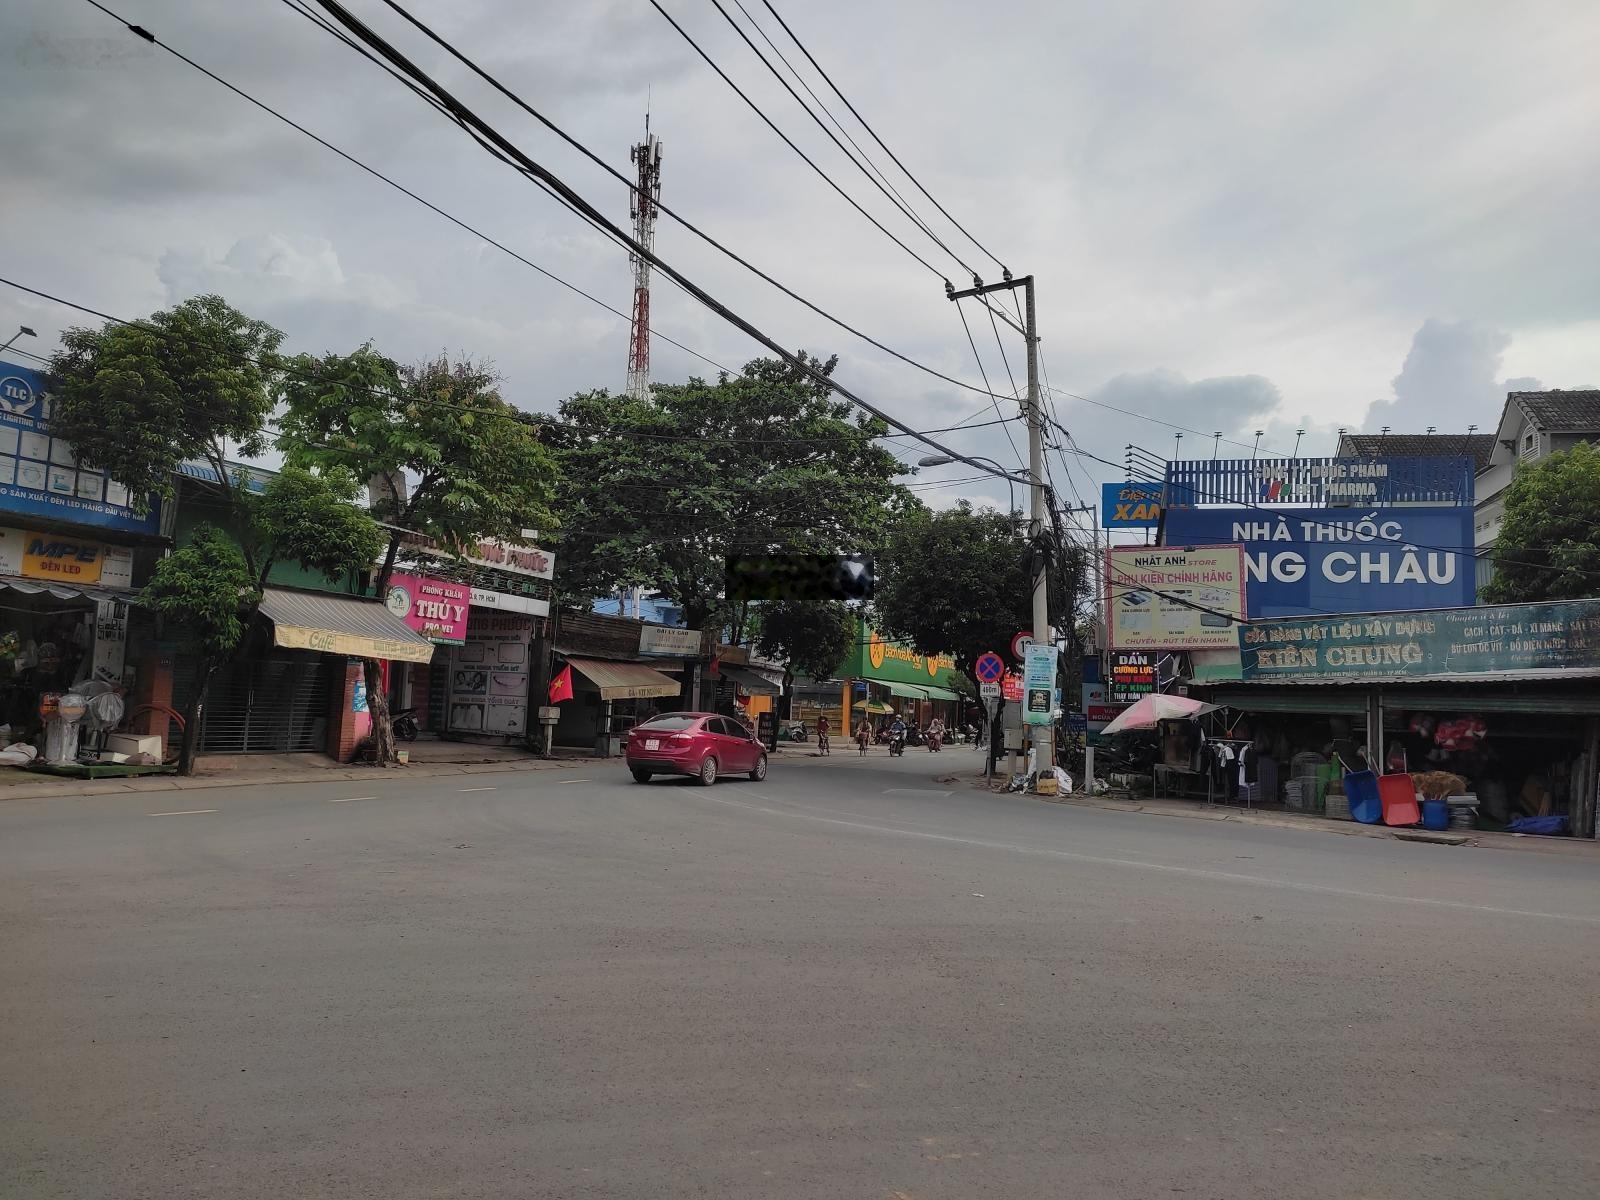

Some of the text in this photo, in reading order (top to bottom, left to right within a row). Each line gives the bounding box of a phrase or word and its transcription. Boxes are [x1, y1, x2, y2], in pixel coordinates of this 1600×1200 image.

[5, 384, 27, 401] TLC
[1253, 459, 1388, 480] CÔNG TY DƯỢC PHẨM
[1322, 482, 1377, 496] PHARMA
[50, 496, 65, 506] ĐÈN
[67, 500, 80, 508] LED
[1112, 504, 1161, 521] XAN
[1232, 512, 1402, 542] NHÀ THUỐC
[27, 538, 98, 563] MPE
[40, 561, 80, 575] ĐÈN LED
[1134, 554, 1162, 566] NHẬT
[1164, 556, 1186, 566] ANH
[1245, 544, 1456, 585] NG CHÂU
[1167, 568, 1200, 582] CHÍNH
[422, 584, 443, 596] PHÒNG
[444, 588, 463, 599] KHÁM
[416, 598, 465, 622] THÚ Y
[1331, 622, 1362, 640] LIỆU
[1364, 620, 1392, 638] XÂY
[1163, 636, 1178, 644] RÚT
[1181, 636, 1200, 644] TIỀN
[1326, 642, 1424, 666] CHUNG
[1114, 665, 1154, 676] CƯỜNG LỰC
